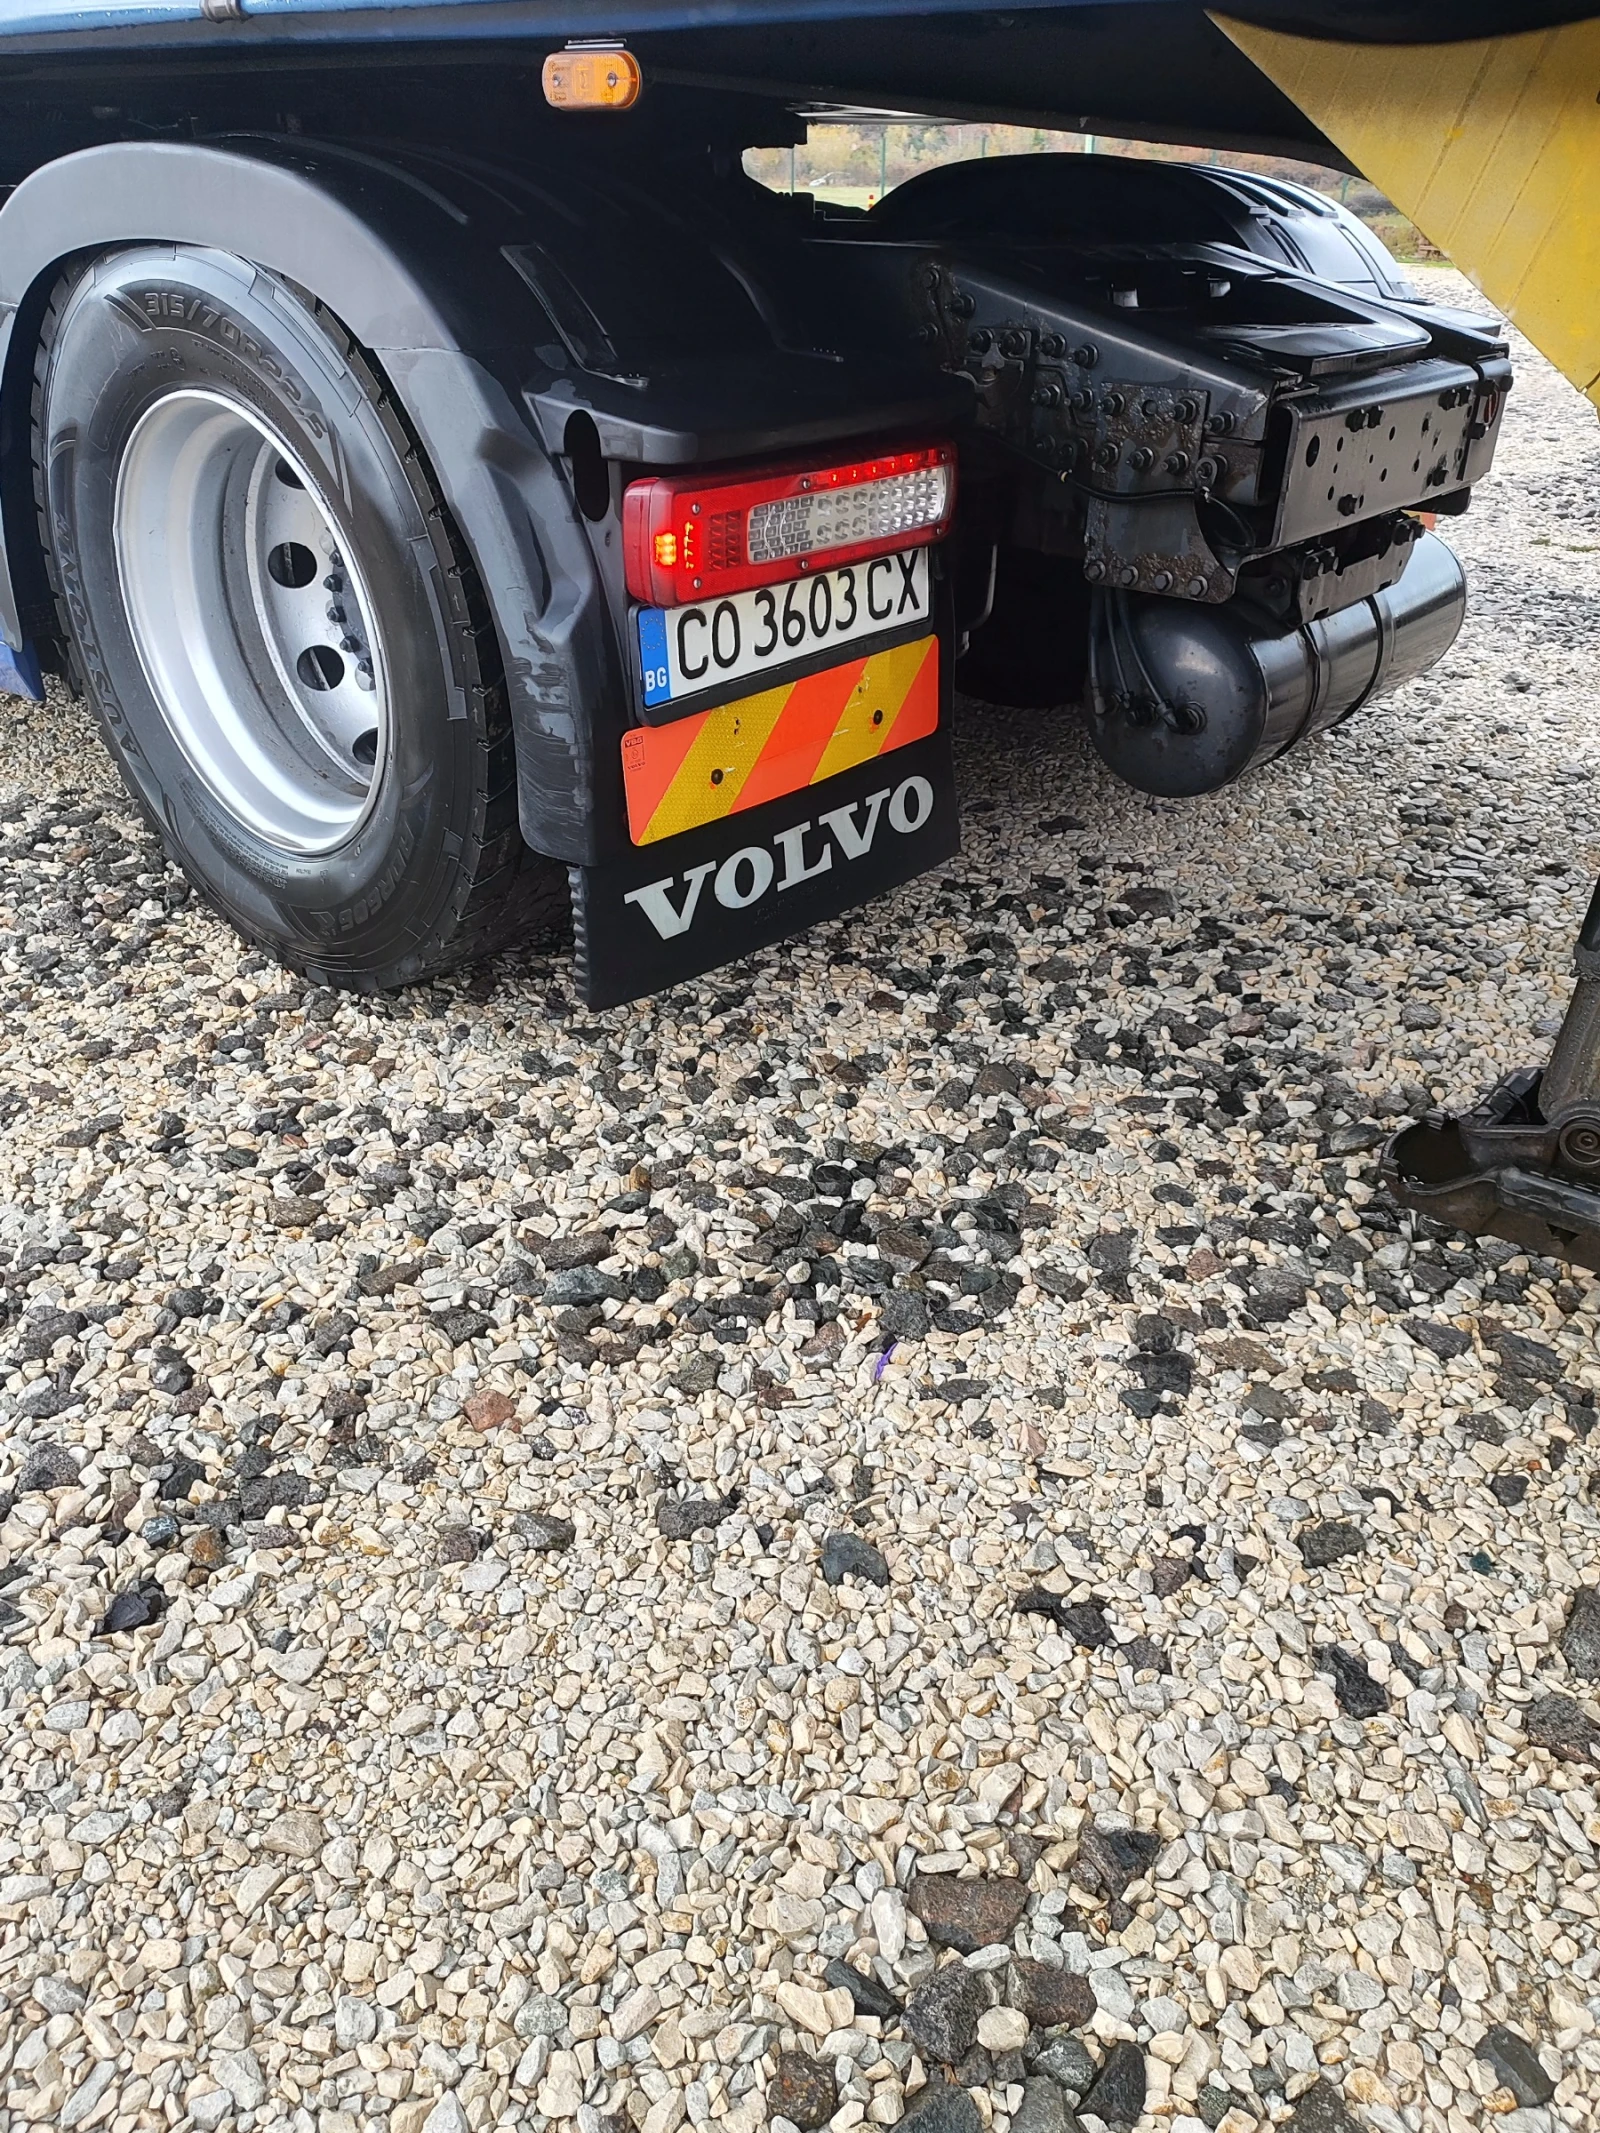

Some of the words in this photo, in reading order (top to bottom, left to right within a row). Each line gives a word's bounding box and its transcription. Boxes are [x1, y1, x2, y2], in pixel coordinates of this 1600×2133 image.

[645, 667, 667, 691] BG
[677, 600, 741, 680] CO
[754, 567, 857, 657] 3603
[867, 548, 921, 621] CX
[624, 775, 934, 940] VOLVO
